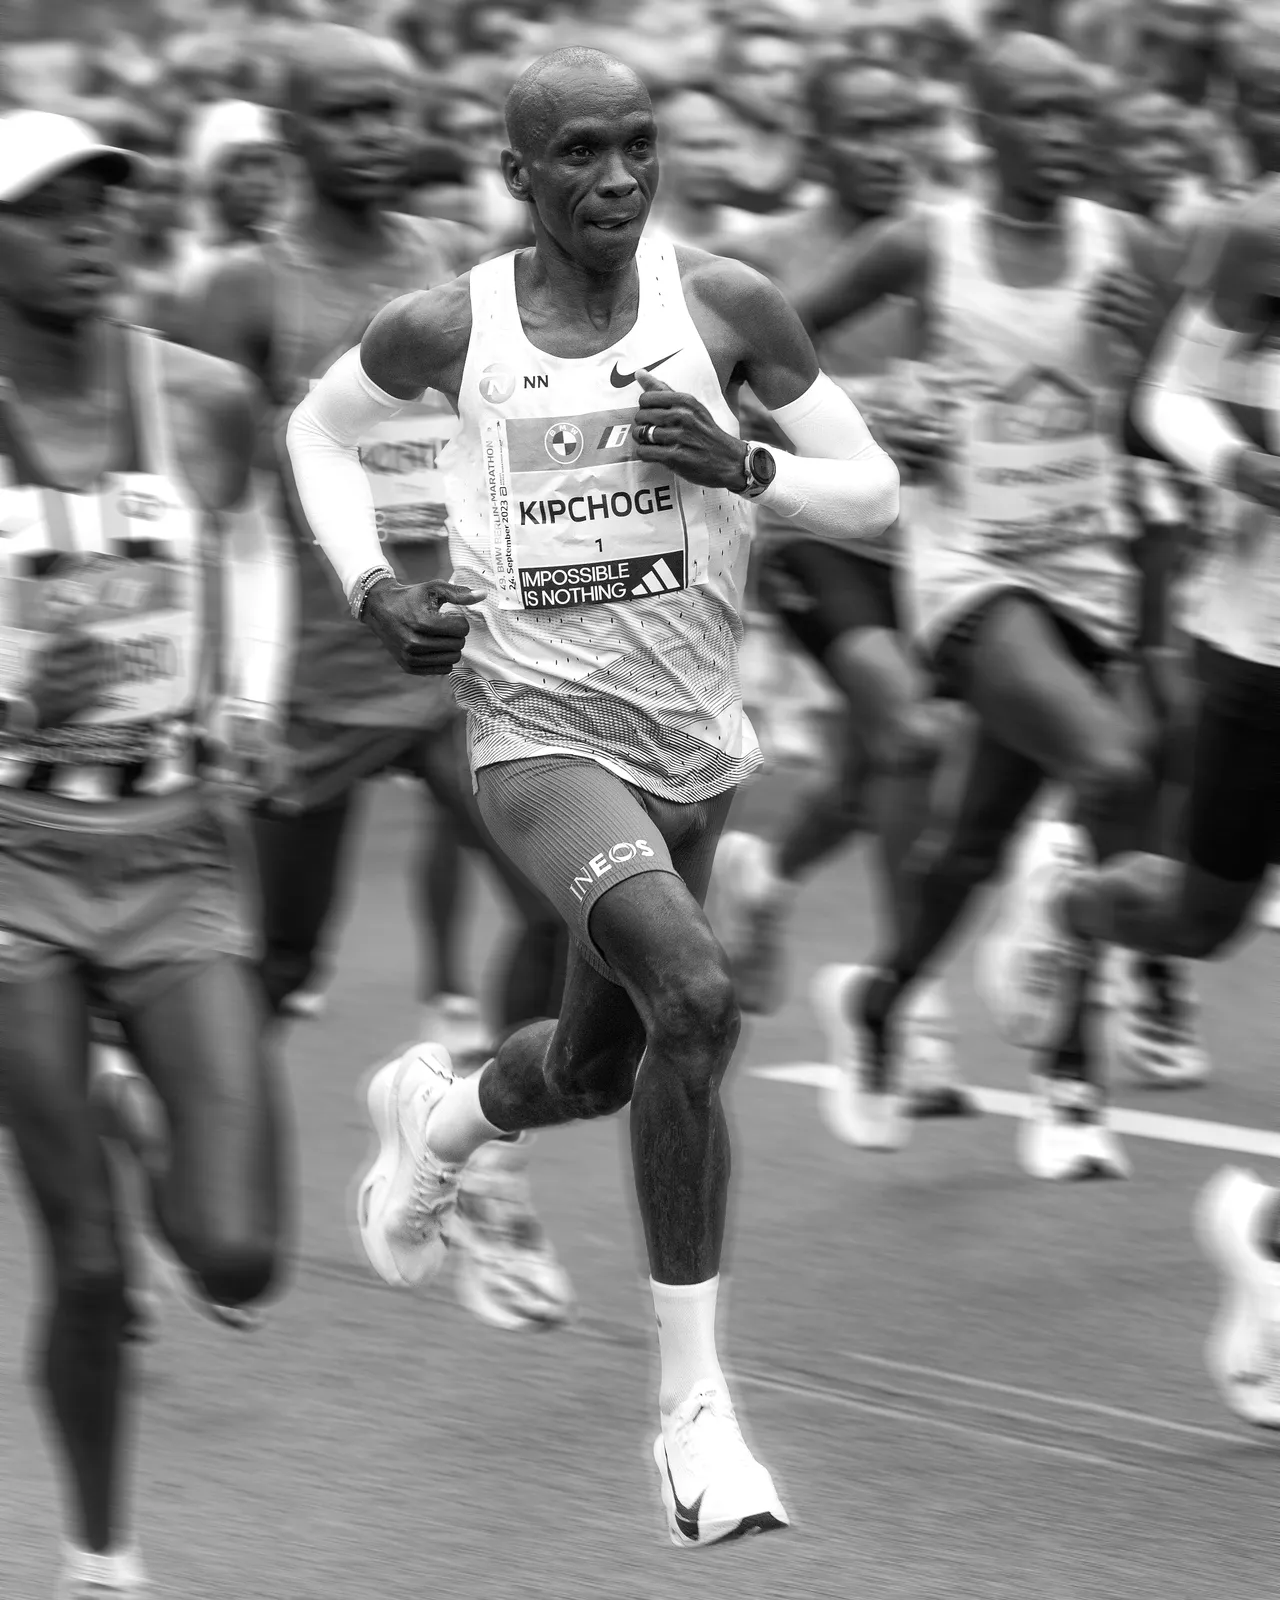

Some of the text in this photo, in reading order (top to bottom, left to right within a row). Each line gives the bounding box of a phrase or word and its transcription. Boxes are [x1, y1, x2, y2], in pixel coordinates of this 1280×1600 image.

[523, 374, 549, 389] NN
[548, 424, 579, 437] BMW
[486, 440, 502, 544] BERLIN-MARATHON
[519, 485, 673, 525] KIPCHOGE
[500, 499, 509, 523] 2023
[505, 524, 514, 574] September
[595, 538, 603, 552] 1
[494, 547, 505, 573] BMW
[521, 562, 630, 588] IMPOSSIBLE
[524, 582, 627, 606] IS NOTHING
[559, 839, 655, 902] INEOS
